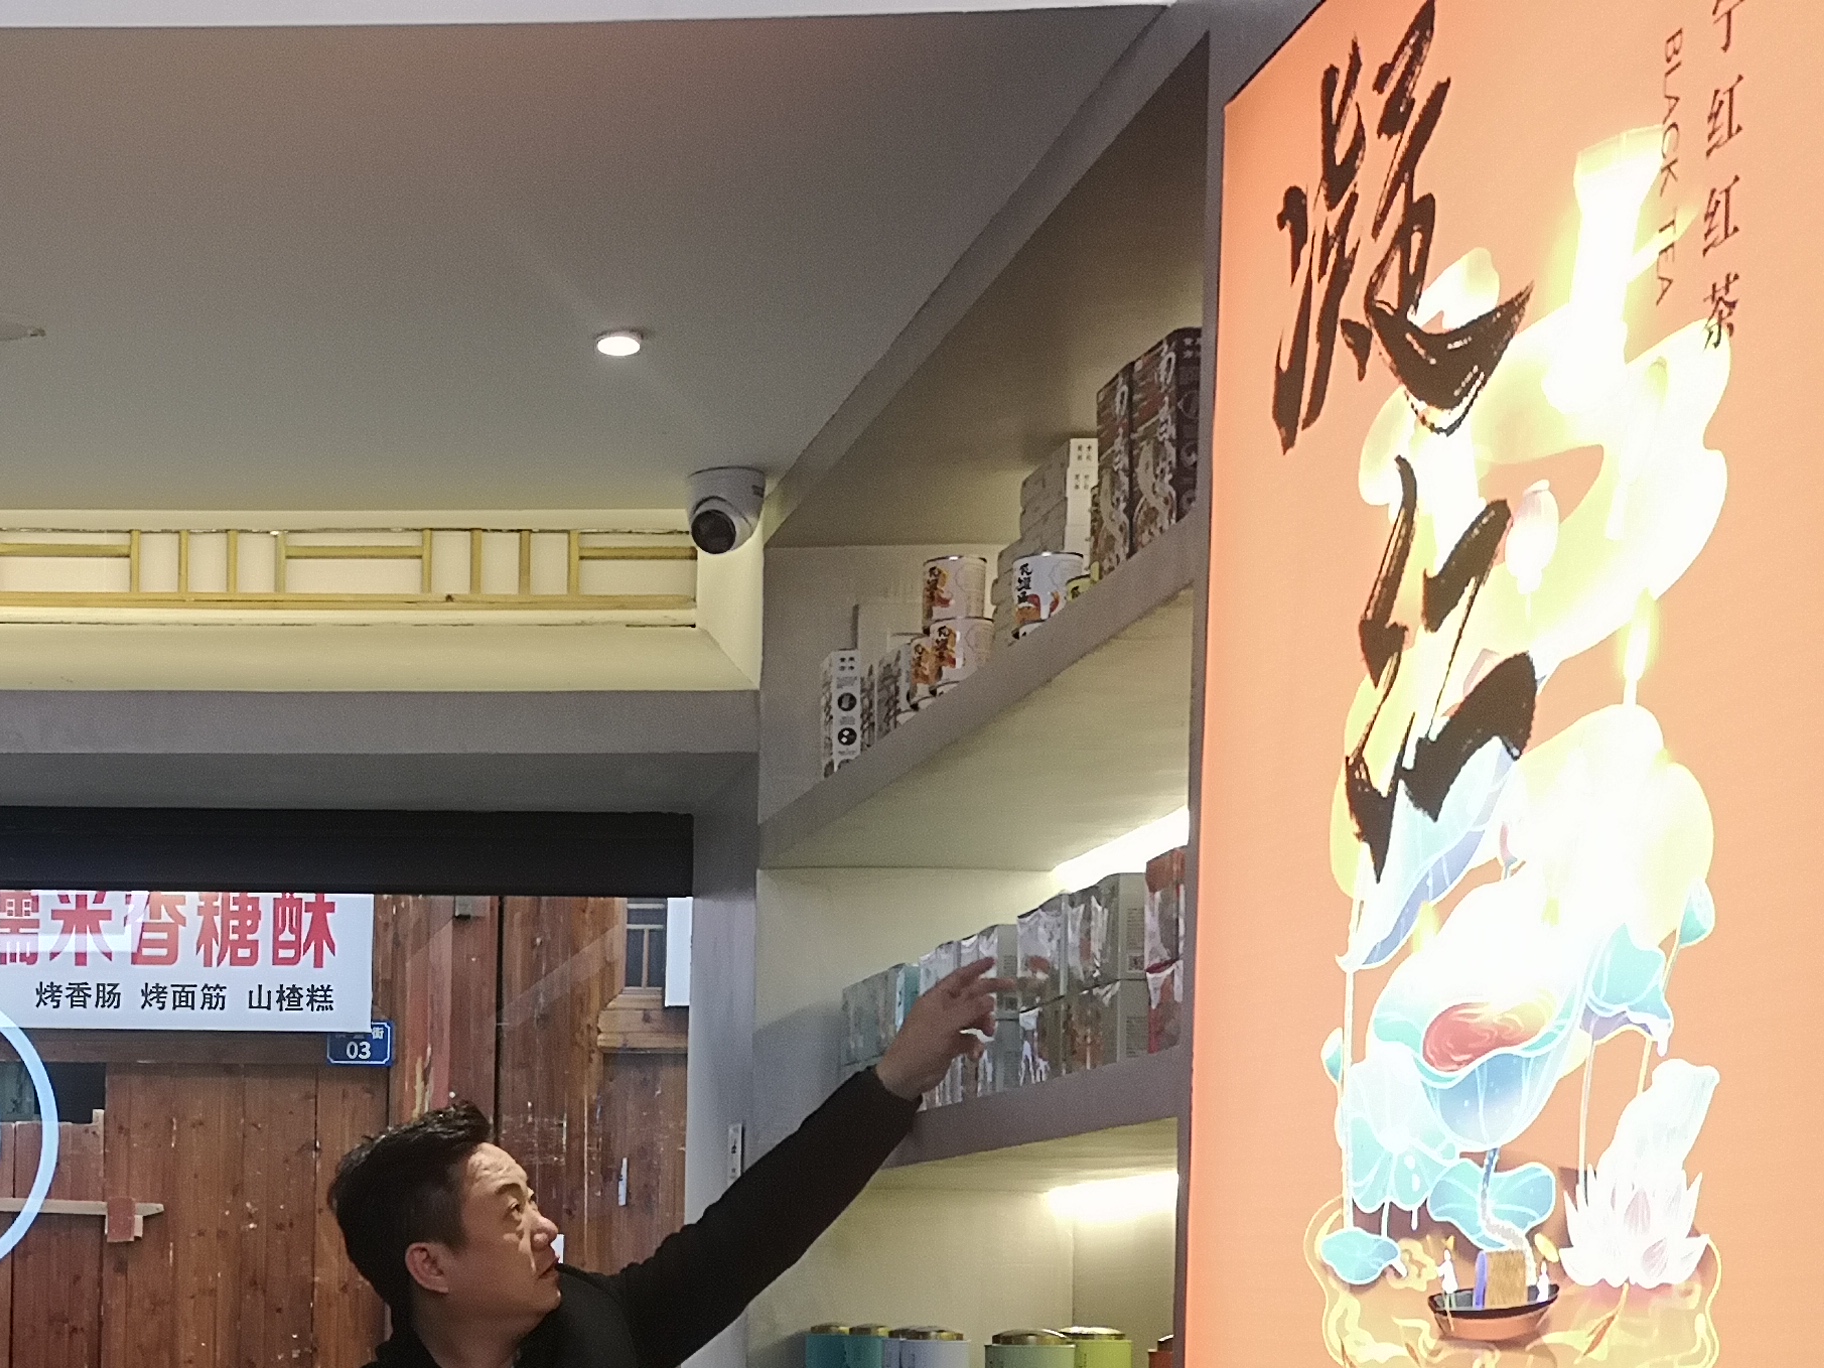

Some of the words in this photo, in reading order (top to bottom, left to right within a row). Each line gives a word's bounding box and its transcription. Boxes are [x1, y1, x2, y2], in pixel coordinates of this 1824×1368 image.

[1660, 27, 1683, 197] BLACK
[1656, 205, 1678, 306] TEA
[35, 981, 122, 1009] 烤香肠
[140, 982, 228, 1011] 烤面筋
[248, 984, 334, 1012] 山楂糕
[346, 1041, 372, 1060] 03
